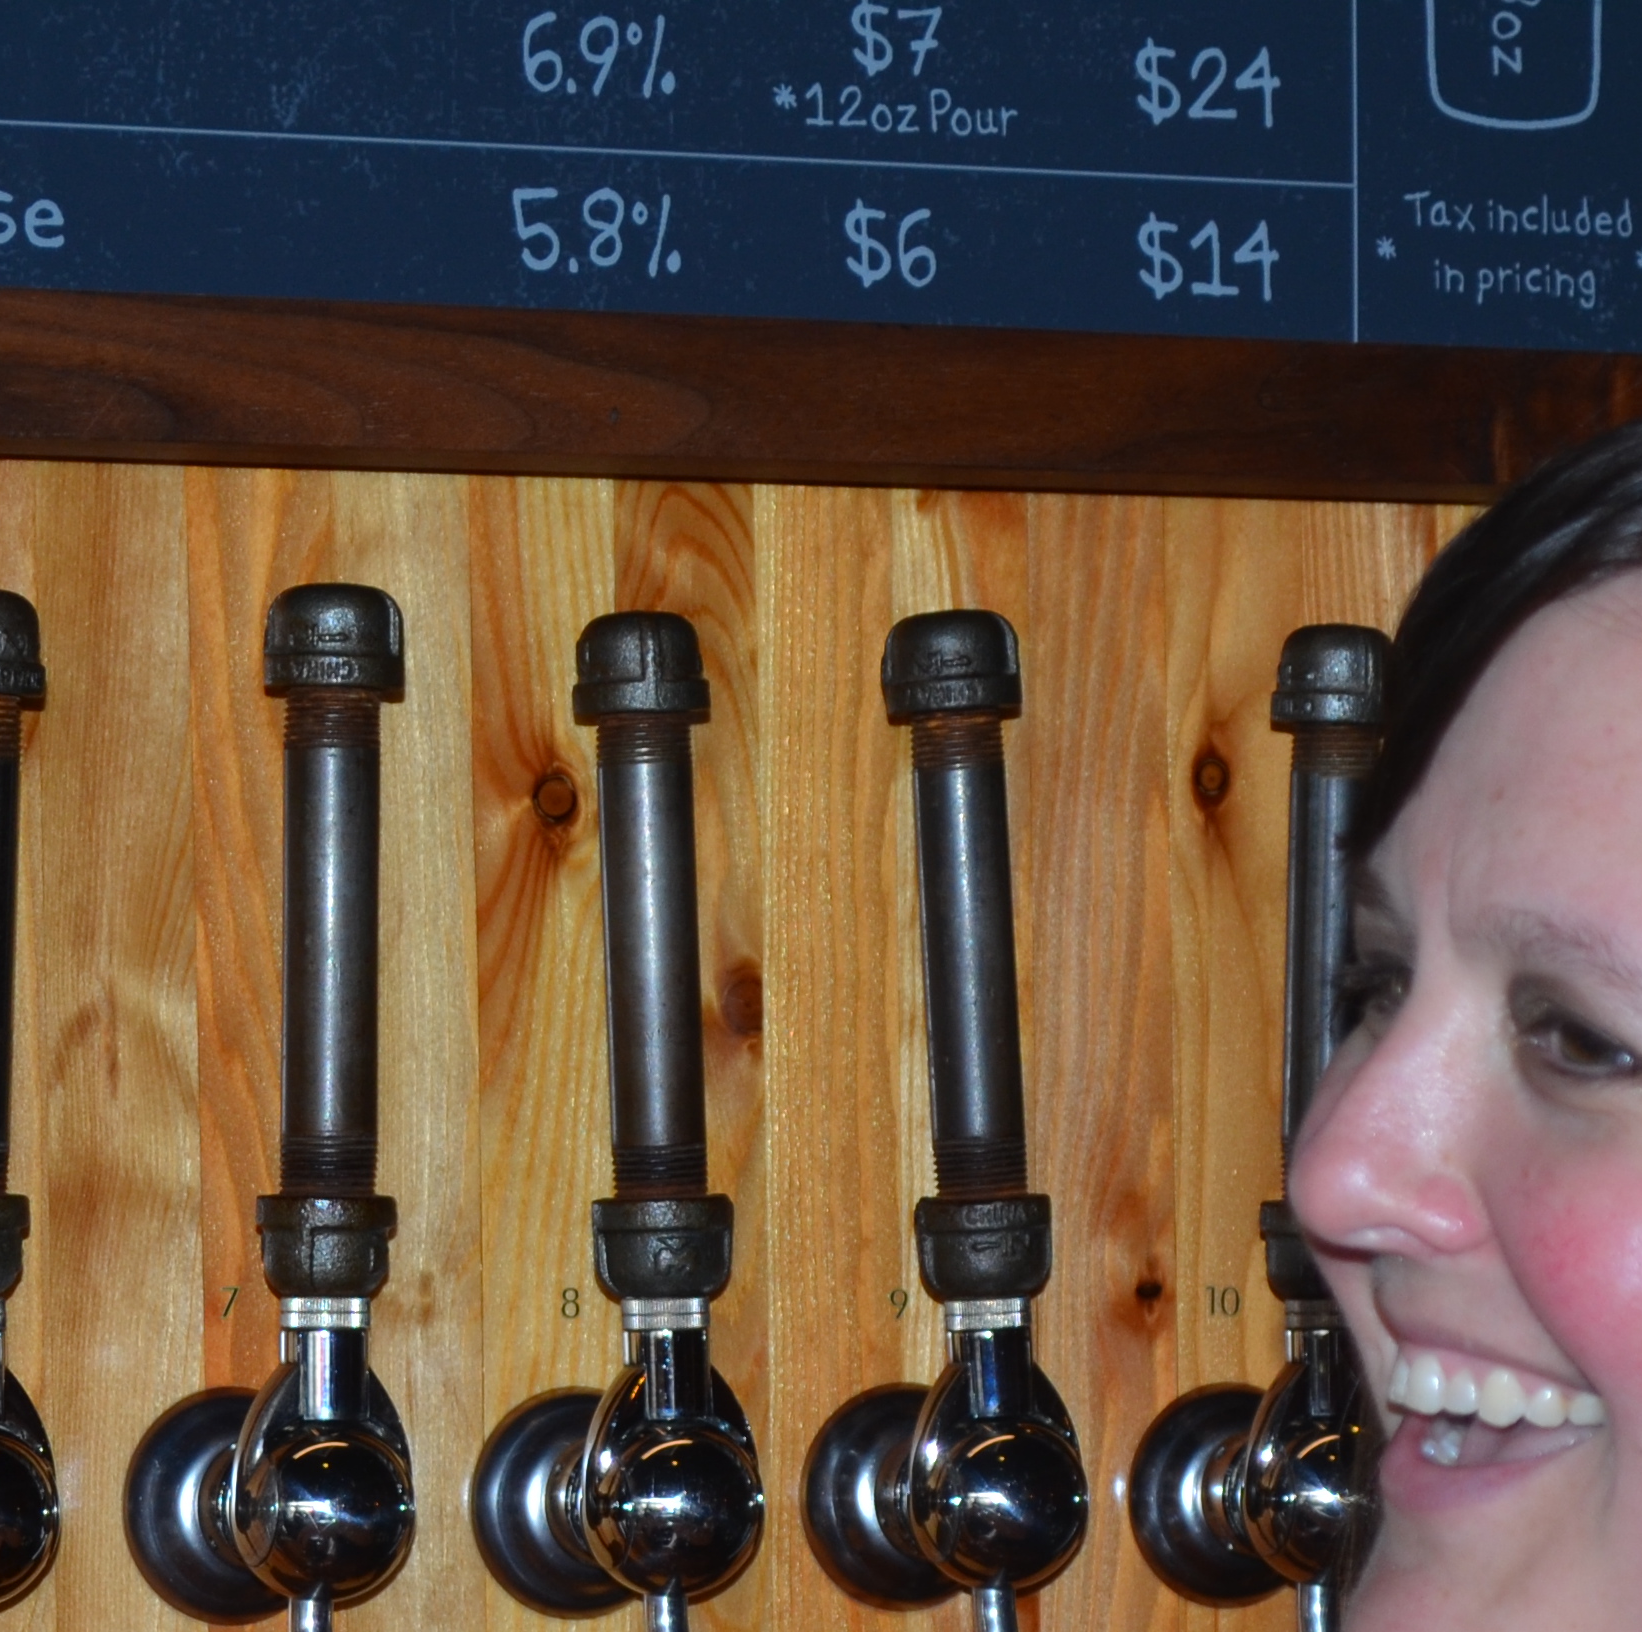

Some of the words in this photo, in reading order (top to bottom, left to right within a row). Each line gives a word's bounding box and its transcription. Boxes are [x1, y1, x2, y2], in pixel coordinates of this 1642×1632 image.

[523, 12, 675, 98] 6.9%
[851, 2, 942, 76] $7
[1492, 0, 1540, 75] oz
[930, 89, 1017, 136] Pour
[1135, 38, 1280, 128] $24
[513, 187, 681, 277] 5.8%
[845, 199, 936, 288] $6
[1404, 191, 1474, 231] Tax
[1488, 196, 1633, 238] included
[1138, 212, 1279, 301] $14
[1434, 260, 1465, 293] in
[1478, 268, 1595, 308] pricing
[221, 1287, 241, 1319] 7
[560, 1288, 581, 1319] 8
[889, 1289, 909, 1321] 9
[1205, 1286, 1241, 1318] 10
